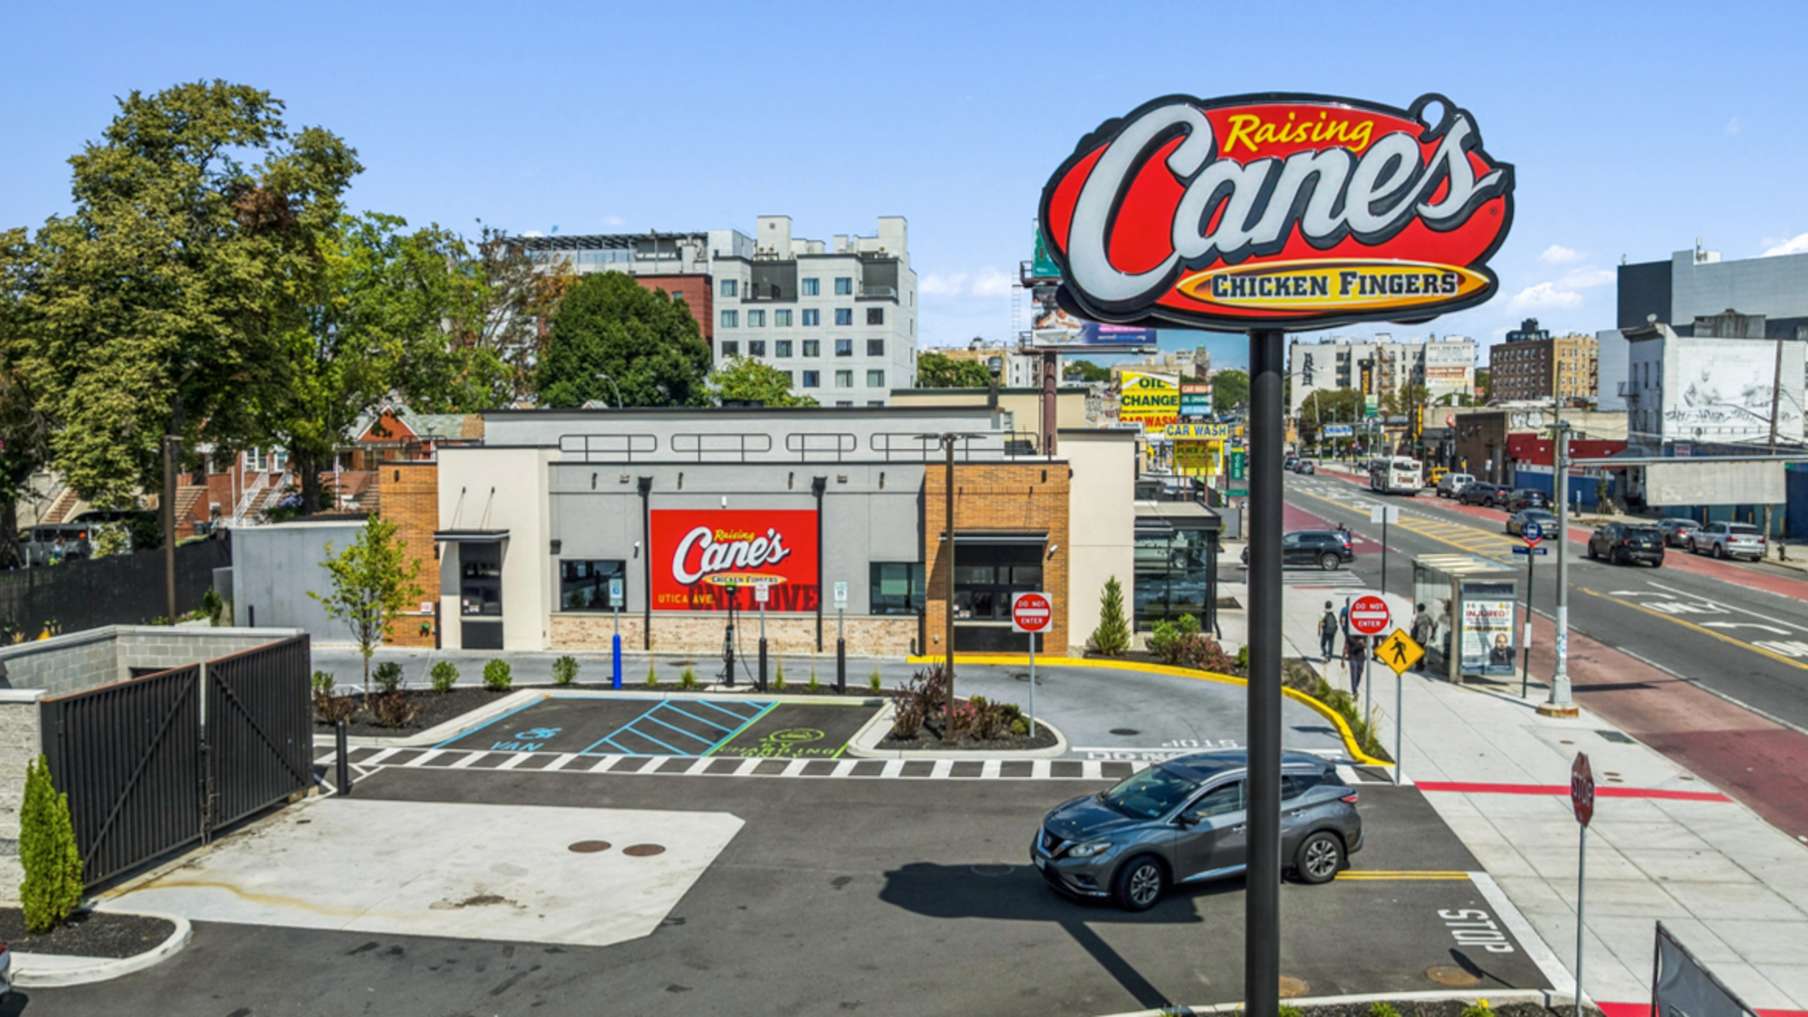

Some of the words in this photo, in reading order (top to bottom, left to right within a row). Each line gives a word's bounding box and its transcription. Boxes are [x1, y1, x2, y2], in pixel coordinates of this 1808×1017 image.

[1223, 111, 1375, 153] Raising
[1068, 100, 1503, 301] Cane's
[1211, 273, 1329, 298] CHICKEN
[1338, 270, 1457, 296] FINGERS
[1138, 376, 1166, 388] OIL
[1120, 395, 1178, 406] CHANGE
[1145, 414, 1178, 428] WASH
[1166, 425, 1190, 436] CAR
[1195, 425, 1227, 436] WASH
[714, 529, 756, 544] Raising
[672, 526, 789, 584] Cane's
[658, 594, 688, 604] UTICA
[1018, 600, 1029, 608] DO
[1031, 600, 1046, 608] NOT
[1355, 602, 1367, 610] DO
[1368, 602, 1384, 610] NOT
[1020, 617, 1043, 625] ENTER
[1358, 620, 1381, 628] ENTER
[490, 741, 544, 752] VAN
[1438, 908, 1515, 953] STOP
